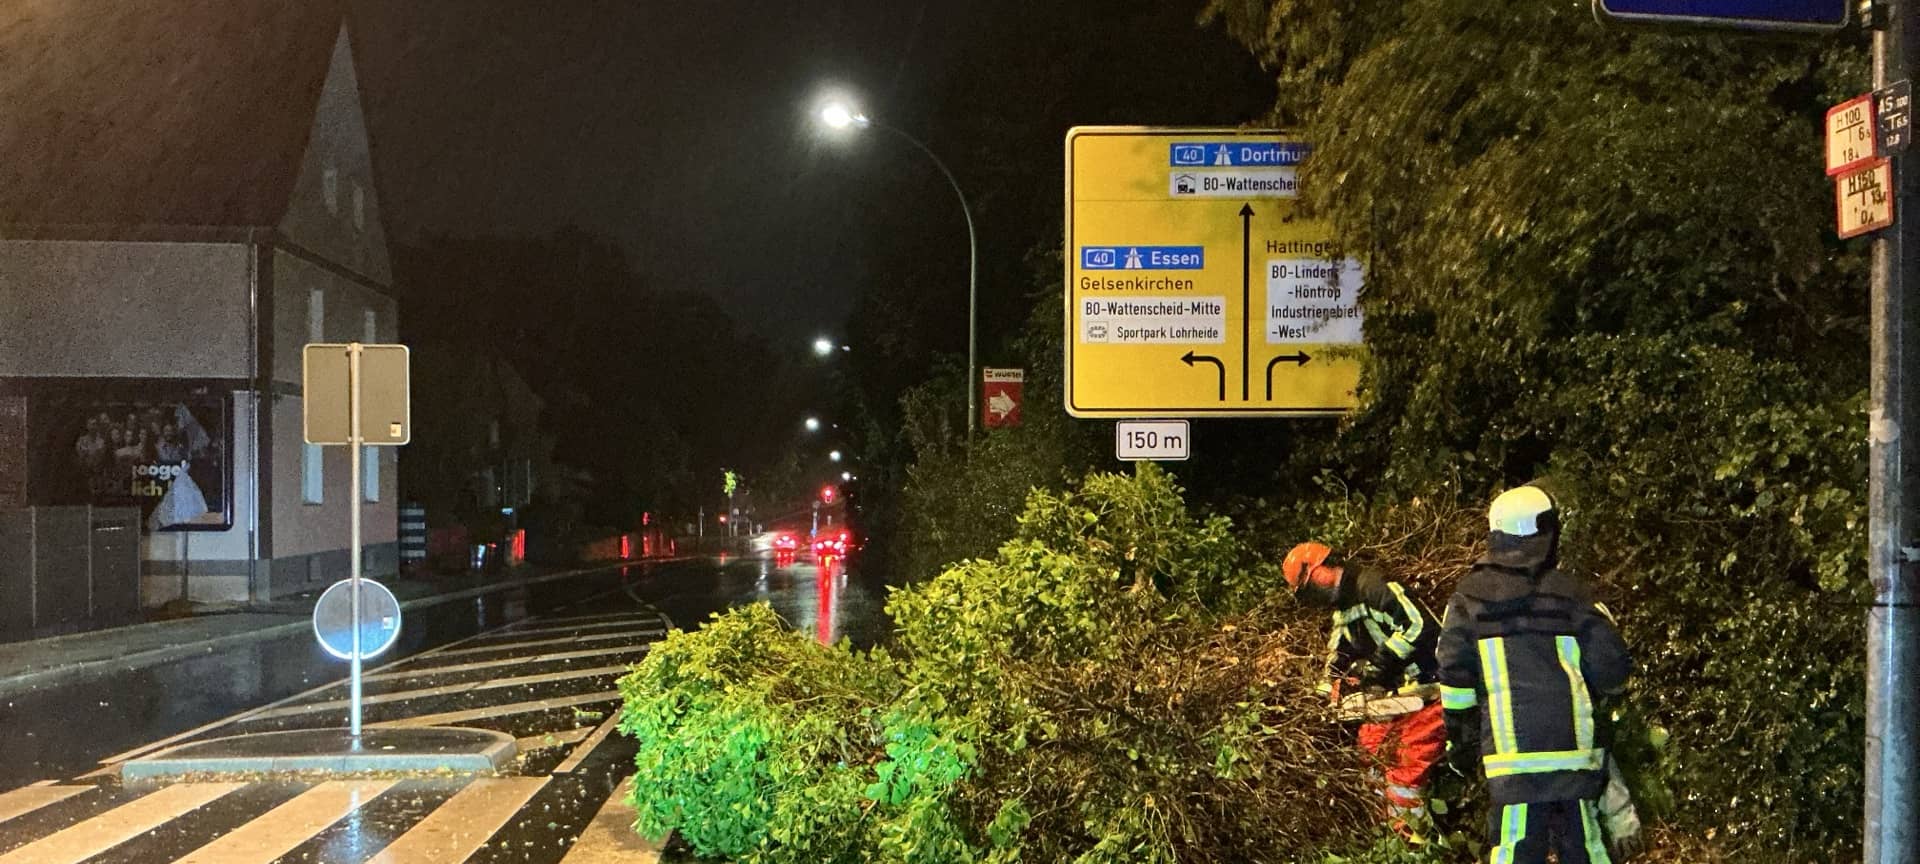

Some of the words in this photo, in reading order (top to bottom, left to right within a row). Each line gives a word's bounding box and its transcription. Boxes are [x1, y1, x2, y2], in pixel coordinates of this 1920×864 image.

[1182, 150, 1197, 161] 40
[1093, 253, 1108, 264] 40
[1152, 251, 1200, 265] Essen
[1080, 276, 1193, 290] Gelsenkirchen
[1085, 302, 1221, 316] BO-Wattenscheid-Mitte
[1271, 304, 1358, 320] Industriegebiet
[1117, 326, 1166, 340] Sportpark
[1170, 326, 1219, 339] Lohrheide
[1272, 325, 1307, 338] -West
[1127, 432, 1157, 449] 150
[1164, 435, 1182, 449] m
